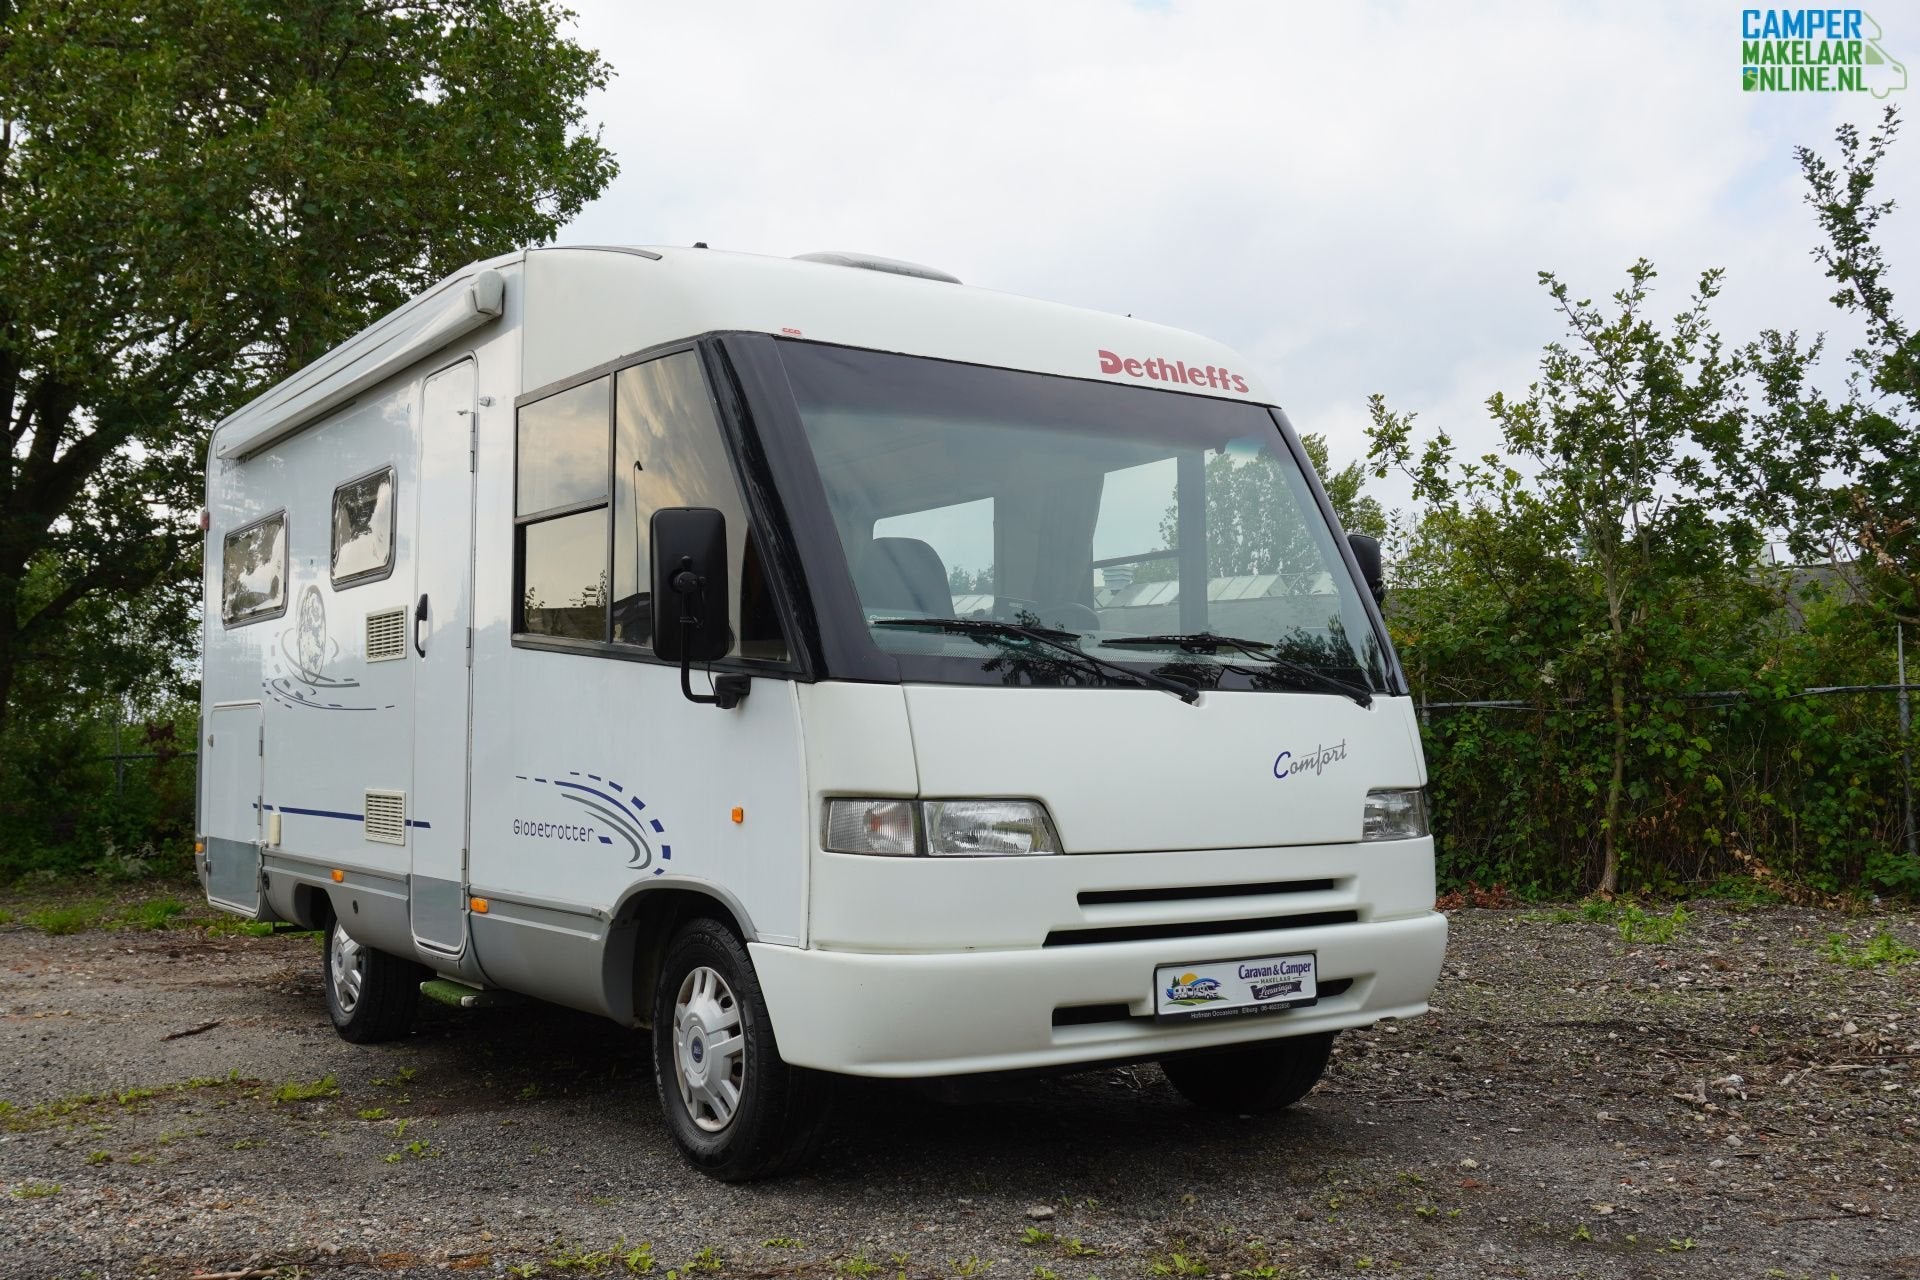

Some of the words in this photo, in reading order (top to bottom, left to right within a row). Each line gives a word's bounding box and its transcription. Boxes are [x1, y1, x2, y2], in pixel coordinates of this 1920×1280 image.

[1098, 350, 1249, 393] Dethleffs
[1274, 739, 1347, 779] Comfort
[513, 819, 594, 842] Globetrotter
[1238, 965, 1272, 979] Caravan
[1273, 965, 1279, 975] &
[1280, 961, 1311, 976] Camper
